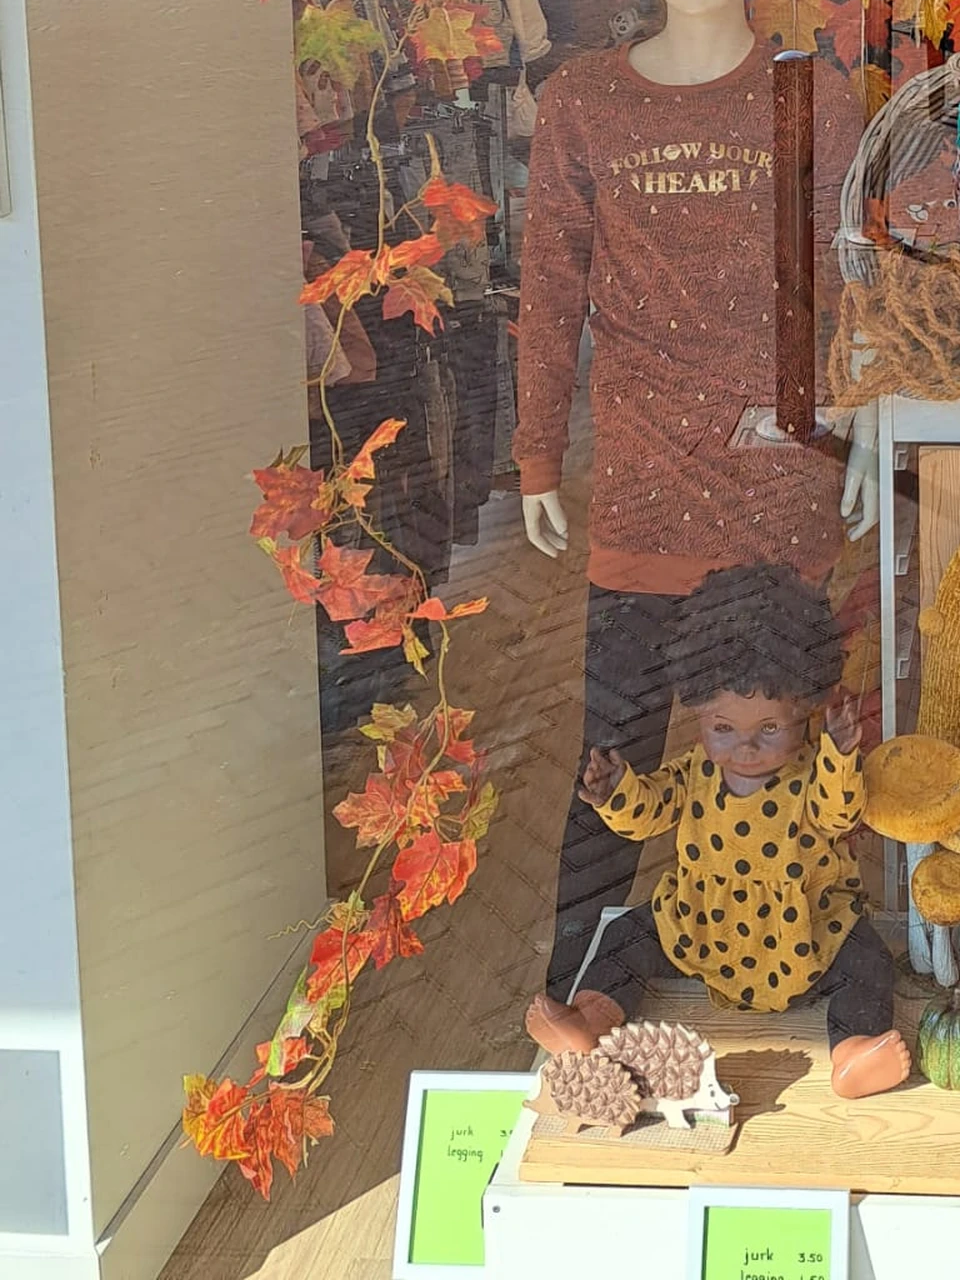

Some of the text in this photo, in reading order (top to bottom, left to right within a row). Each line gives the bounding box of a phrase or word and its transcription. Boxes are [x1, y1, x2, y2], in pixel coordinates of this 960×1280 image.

[608, 142, 774, 176] FOLLOW YOUR
[644, 169, 742, 195] HEART
[450, 1125, 474, 1141] jurk
[447, 1144, 484, 1163] legging
[743, 1247, 823, 1266] jurk 3.50
